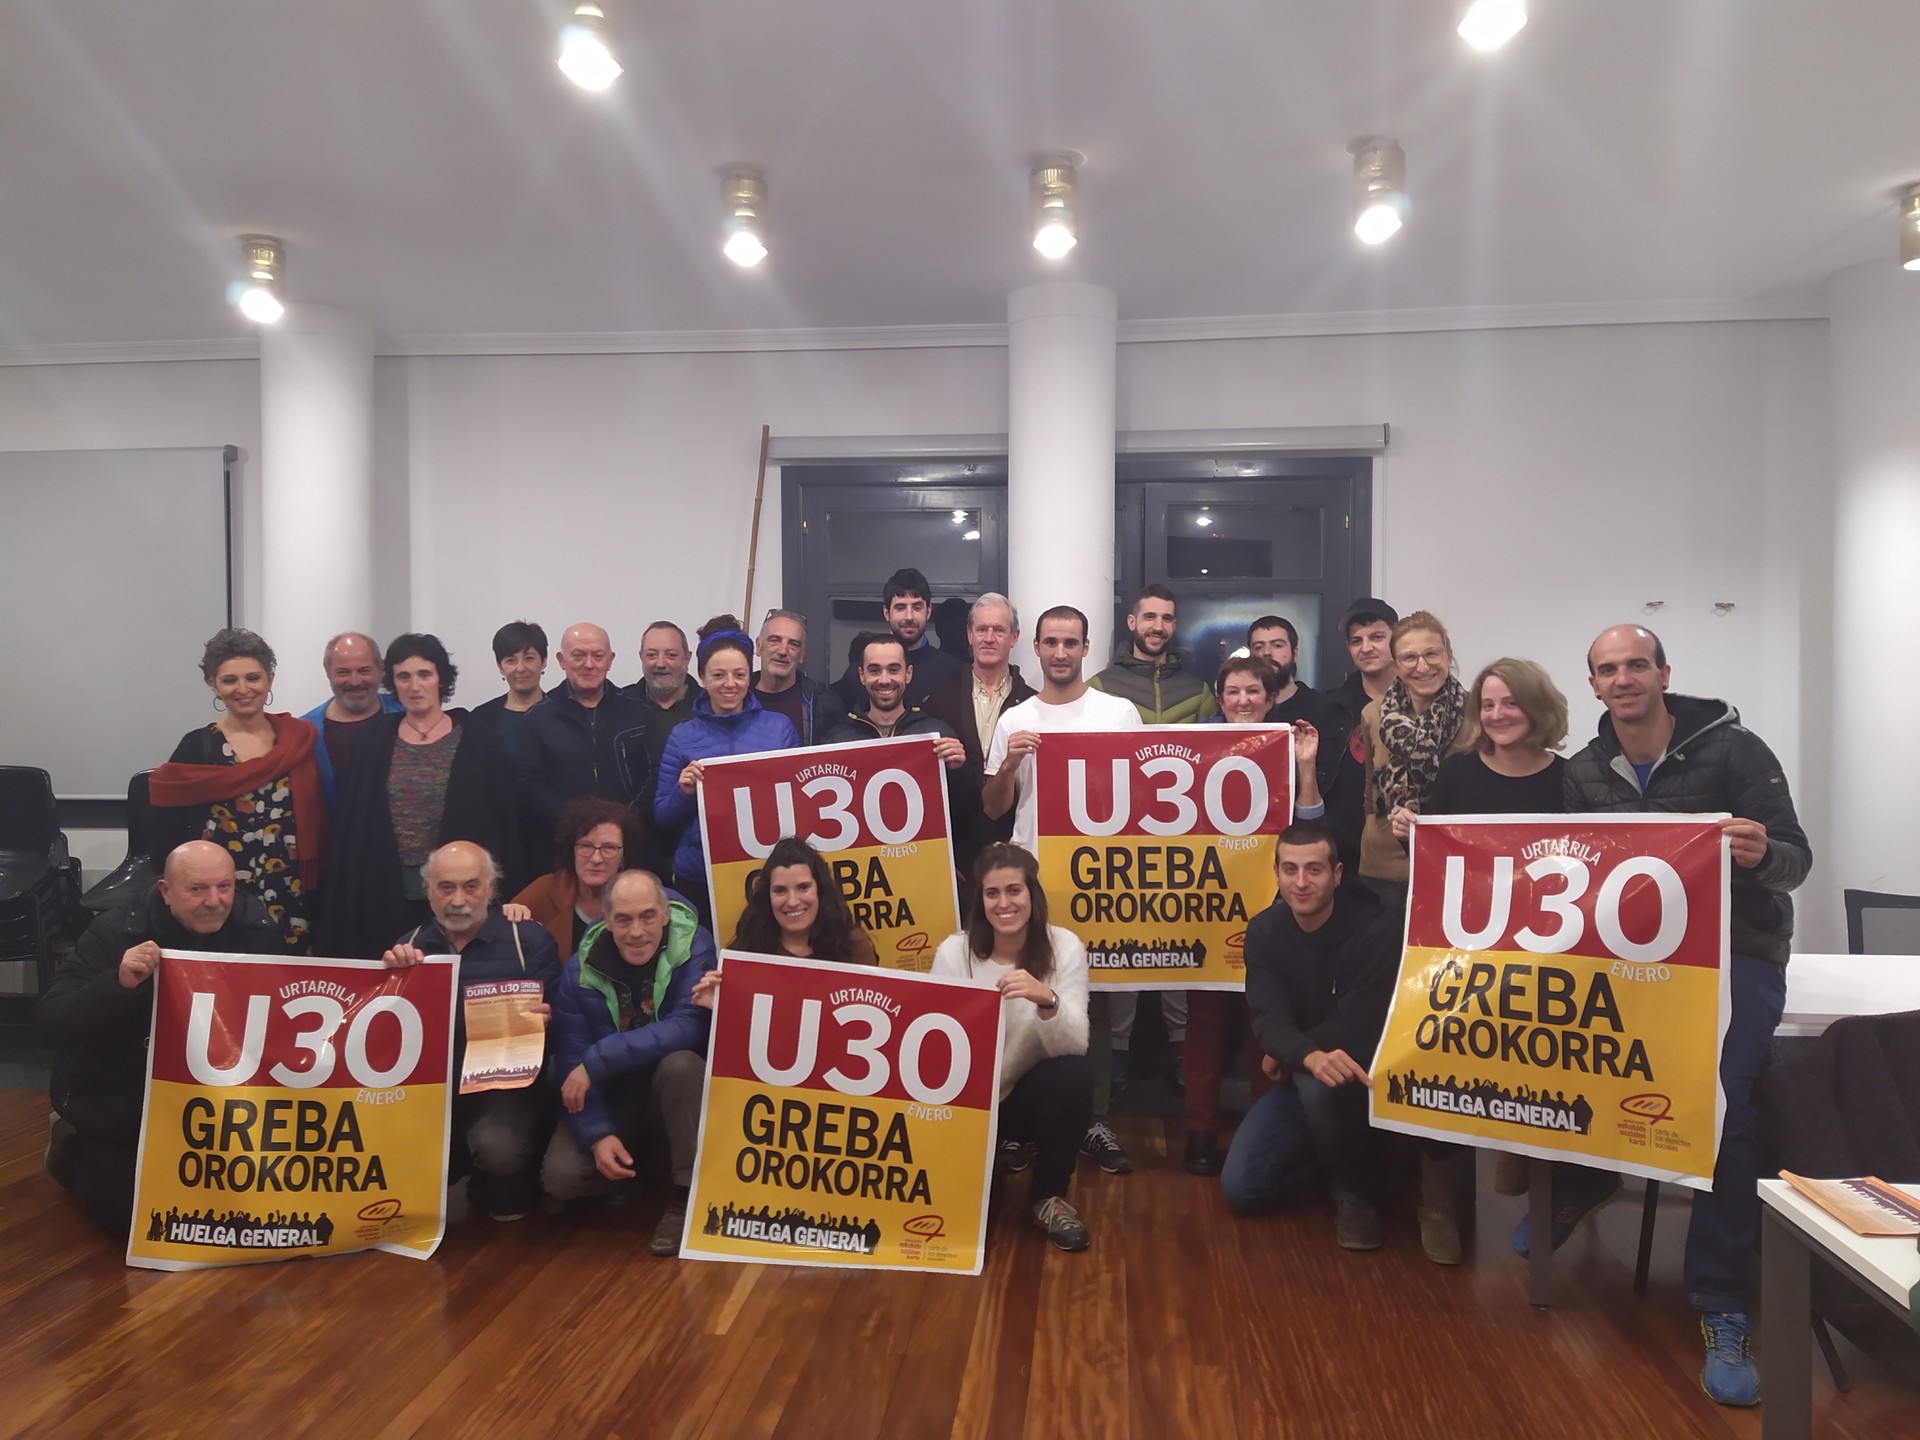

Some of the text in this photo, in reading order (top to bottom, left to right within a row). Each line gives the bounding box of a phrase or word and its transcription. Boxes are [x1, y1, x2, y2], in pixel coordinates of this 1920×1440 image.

[1135, 743, 1202, 765] URTARRILA
[795, 763, 858, 784] URTARRILA
[1068, 755, 1269, 837] U30
[733, 768, 924, 859] U30
[880, 843, 918, 858] ENERO
[1217, 836, 1259, 851] ENERO
[1522, 839, 1602, 866] URTARRILA
[1070, 846, 1228, 890] GREBA
[1070, 892, 1248, 923] OROKORRA
[1442, 856, 1688, 963] U30
[1132, 952, 1199, 968] GENERAL
[1611, 961, 1671, 982] ENERO
[279, 980, 356, 1005] URTARRILA
[467, 987, 497, 997] DUINA
[500, 983, 519, 993] U30
[830, 988, 902, 1018] URTARRILA
[1429, 960, 1625, 1033] GREBA
[186, 992, 423, 1089] U30
[749, 993, 971, 1105] U30
[1415, 1014, 1654, 1082] OROKORRA
[356, 1088, 406, 1105] ENERO
[907, 1103, 953, 1121] ENERO
[1412, 1086, 1582, 1132] HUELGA GENERAL
[182, 1098, 364, 1152] GREBA
[742, 1094, 913, 1164] GREBA
[179, 1152, 387, 1192] OROKORRA
[736, 1147, 932, 1205] OROKORRA
[170, 1223, 323, 1247] HUELGA GENERAL
[726, 1217, 870, 1252] HUELGA GENERAL
